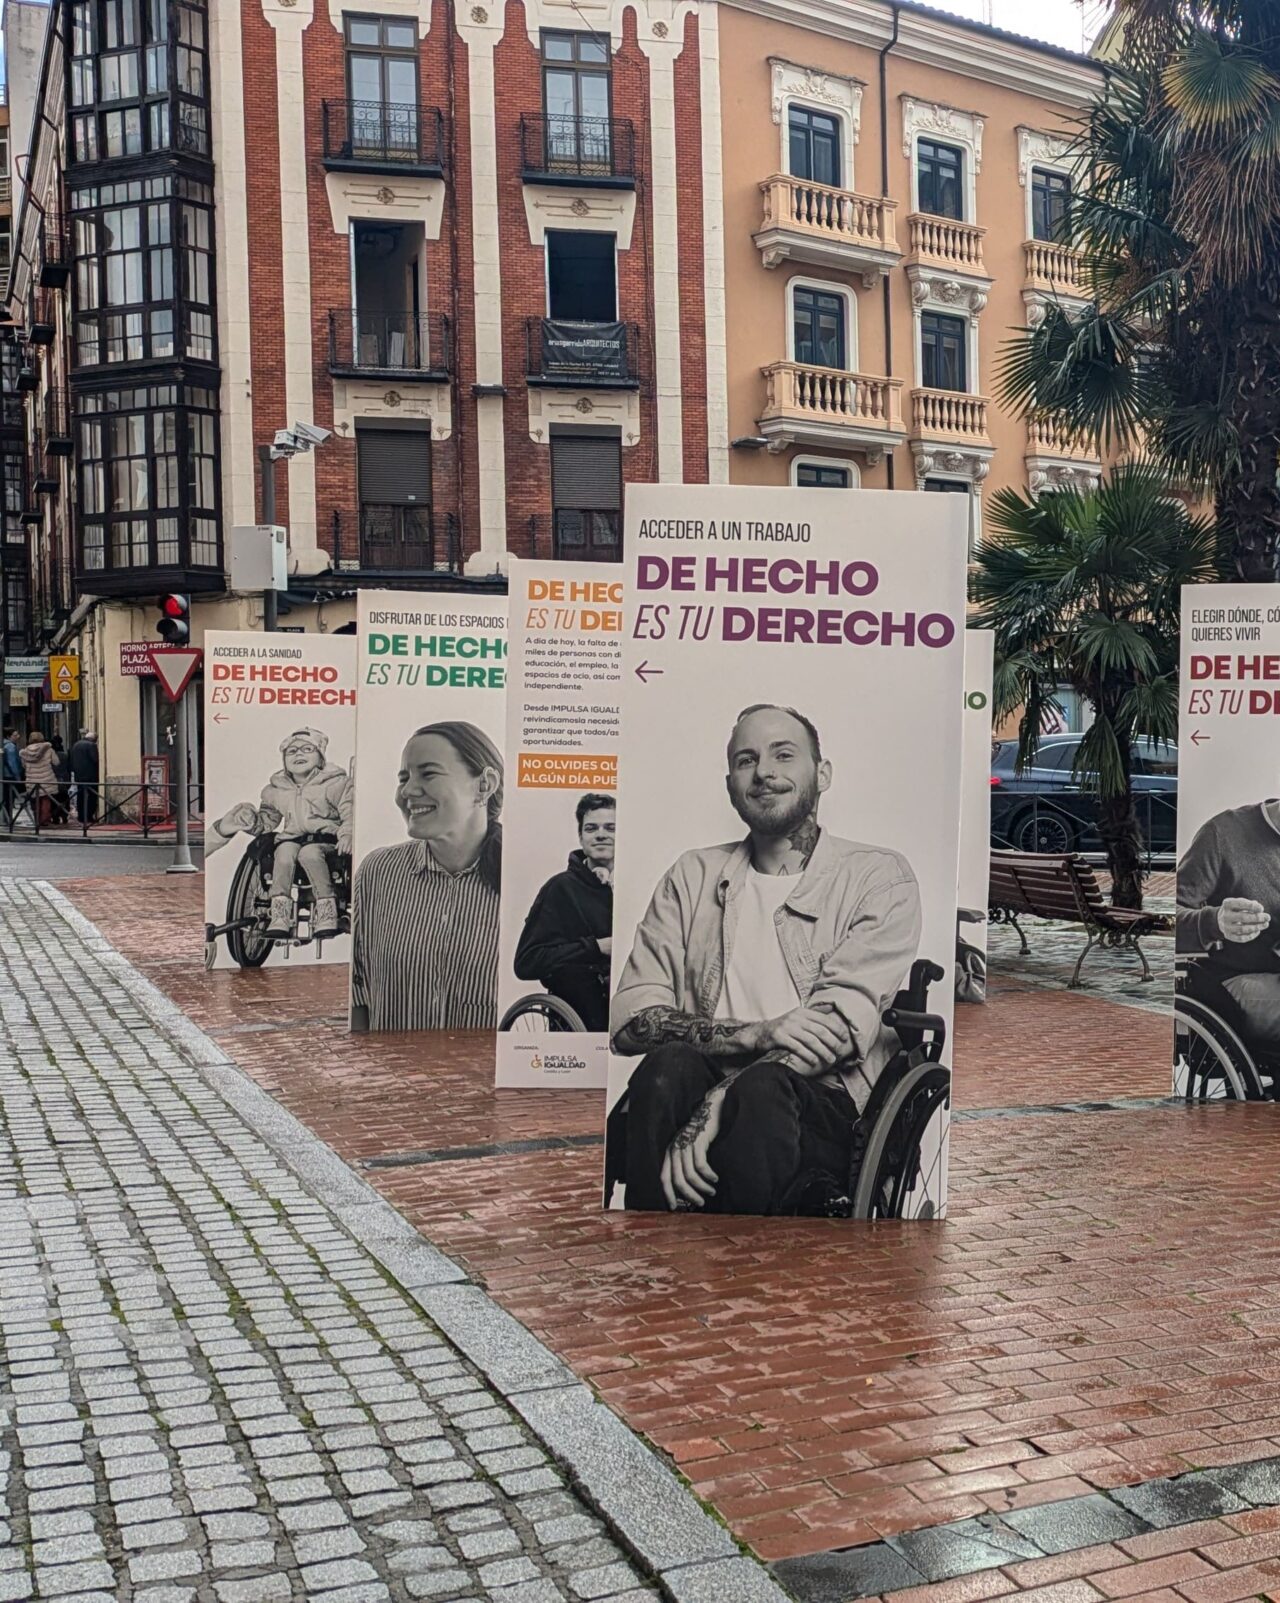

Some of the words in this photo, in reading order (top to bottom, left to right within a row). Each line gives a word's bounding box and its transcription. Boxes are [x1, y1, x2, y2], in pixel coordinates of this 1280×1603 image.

[639, 519, 703, 540] ACCEDER
[707, 521, 718, 540] A
[721, 521, 742, 541] UN
[746, 522, 811, 543] TRABAJO
[636, 555, 697, 591] DE
[705, 557, 879, 596] HECHO
[528, 579, 565, 601] DE
[369, 611, 421, 625] DISFRUTAR
[424, 613, 437, 626] DE
[439, 614, 457, 627] LOS
[460, 615, 504, 629] ESPACIOS
[526, 608, 549, 629] ES
[553, 608, 576, 630] TU
[1192, 609, 1225, 624] ELEGIR
[1228, 606, 1265, 625] DÓNDE,
[632, 604, 670, 640] ES
[678, 605, 715, 641] TU
[722, 606, 955, 648] DERECHO
[1191, 626, 1232, 642] QUIERES
[1235, 627, 1261, 641] VIVIR
[121, 644, 147, 652] HORNO
[368, 633, 408, 656] DE
[415, 635, 507, 659] HECH
[548, 637, 558, 645] de
[578, 638, 586, 646] la
[587, 639, 606, 647] falta
[121, 654, 150, 664] PLAZA
[213, 647, 248, 658] ACCEDER
[250, 648, 256, 657] A
[257, 648, 267, 658] LA
[269, 649, 302, 659] SANIDAD
[560, 651, 597, 659] personas
[121, 665, 156, 674] BOUTIQU
[213, 664, 245, 681] DE
[250, 665, 338, 683] HECHO
[366, 663, 391, 685] ES
[397, 664, 420, 686] TU
[426, 665, 506, 689] DERE
[524, 671, 560, 679] espacios
[1190, 655, 1231, 680] DE
[211, 687, 231, 704] ES
[235, 687, 255, 704] TU
[964, 691, 987, 710] O
[1188, 689, 1214, 715] ES
[1219, 689, 1244, 715] TU
[523, 704, 549, 712] Desde
[551, 705, 589, 713] IMPULSA
[523, 728, 565, 736] garantizar
[567, 729, 583, 737] que
[584, 729, 620, 737] todos/as
[522, 759, 541, 769] NO
[544, 760, 598, 771] OLVIDES
[521, 773, 567, 784] ALGÚN
[569, 773, 591, 785] DÍA
[592, 774, 617, 786] PUE
